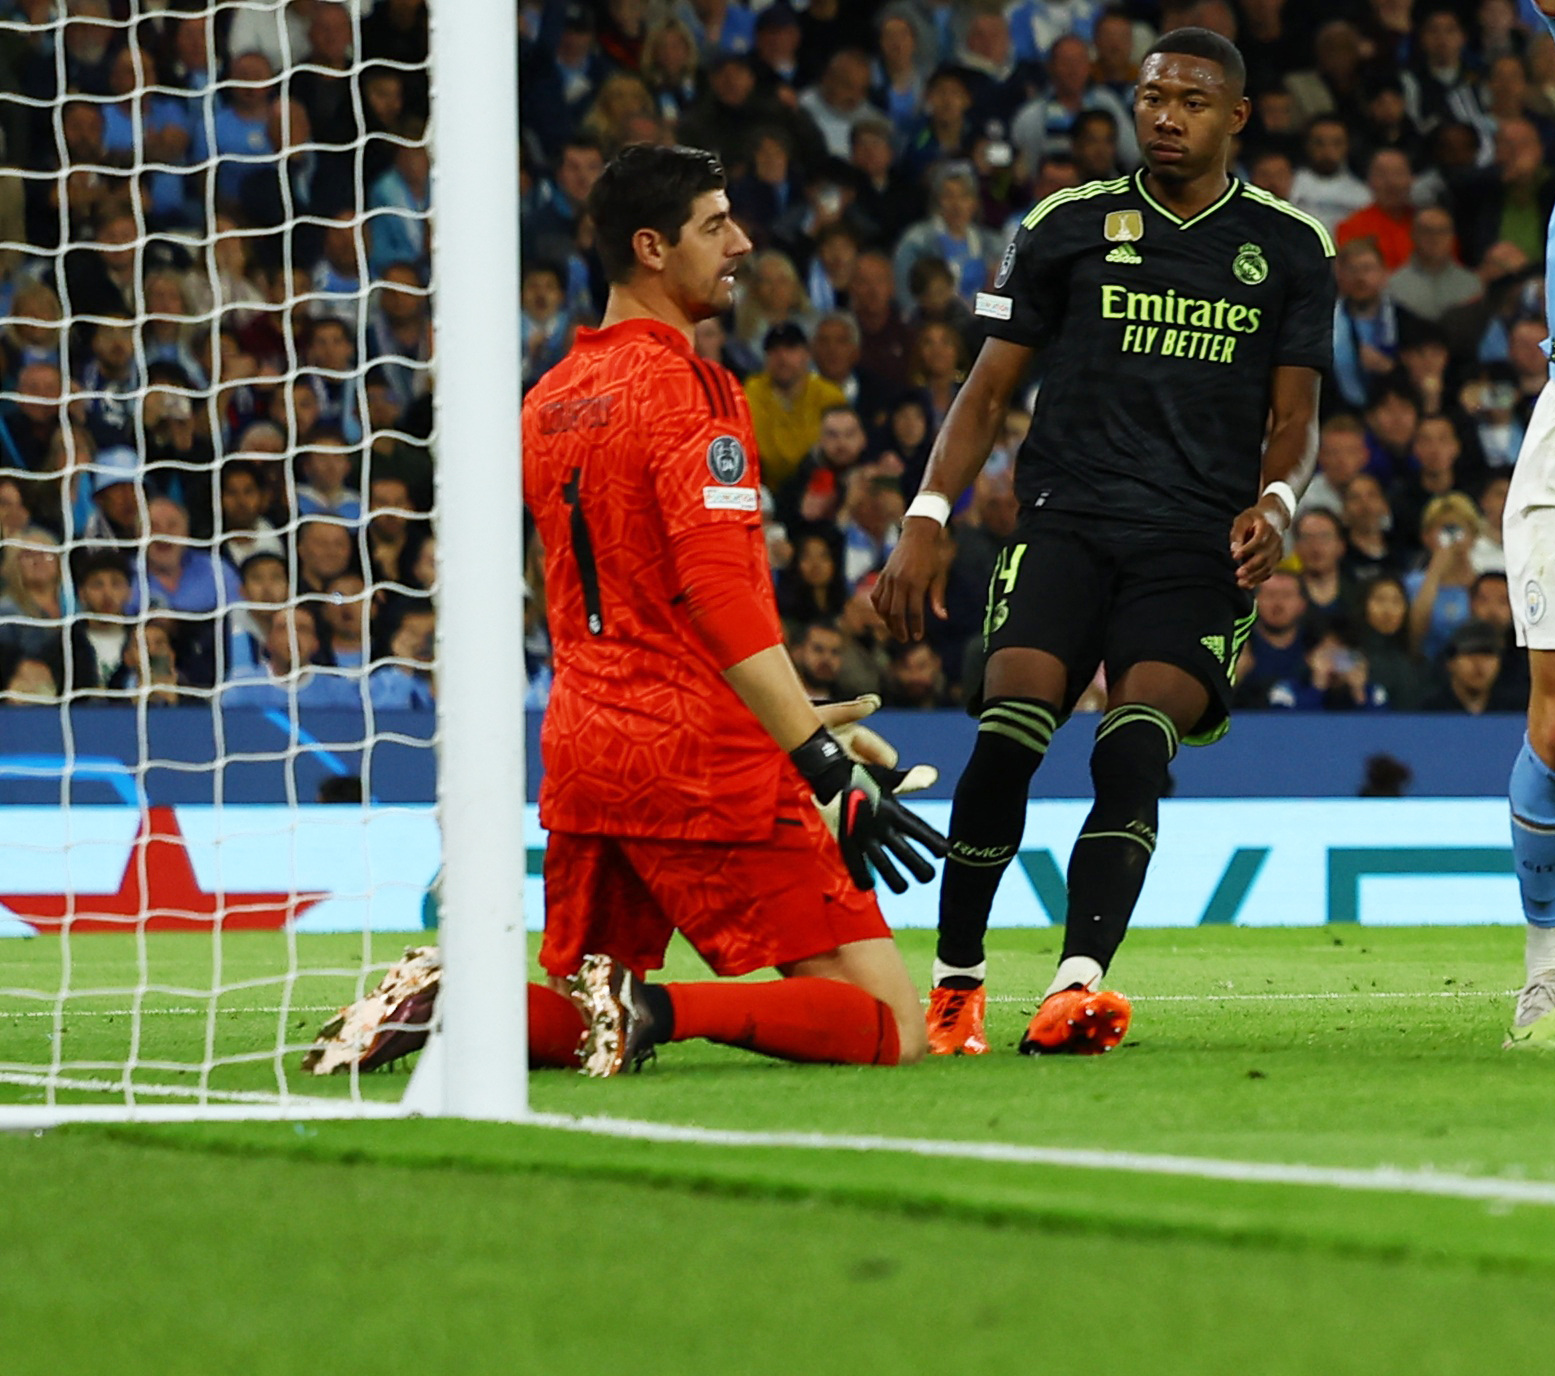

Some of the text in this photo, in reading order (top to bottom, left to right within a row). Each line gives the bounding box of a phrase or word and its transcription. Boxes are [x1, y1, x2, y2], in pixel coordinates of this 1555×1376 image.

[1101, 284, 1262, 334] Emirates
[1121, 325, 1237, 363] FLY BETTER
[998, 543, 1028, 594] 4
